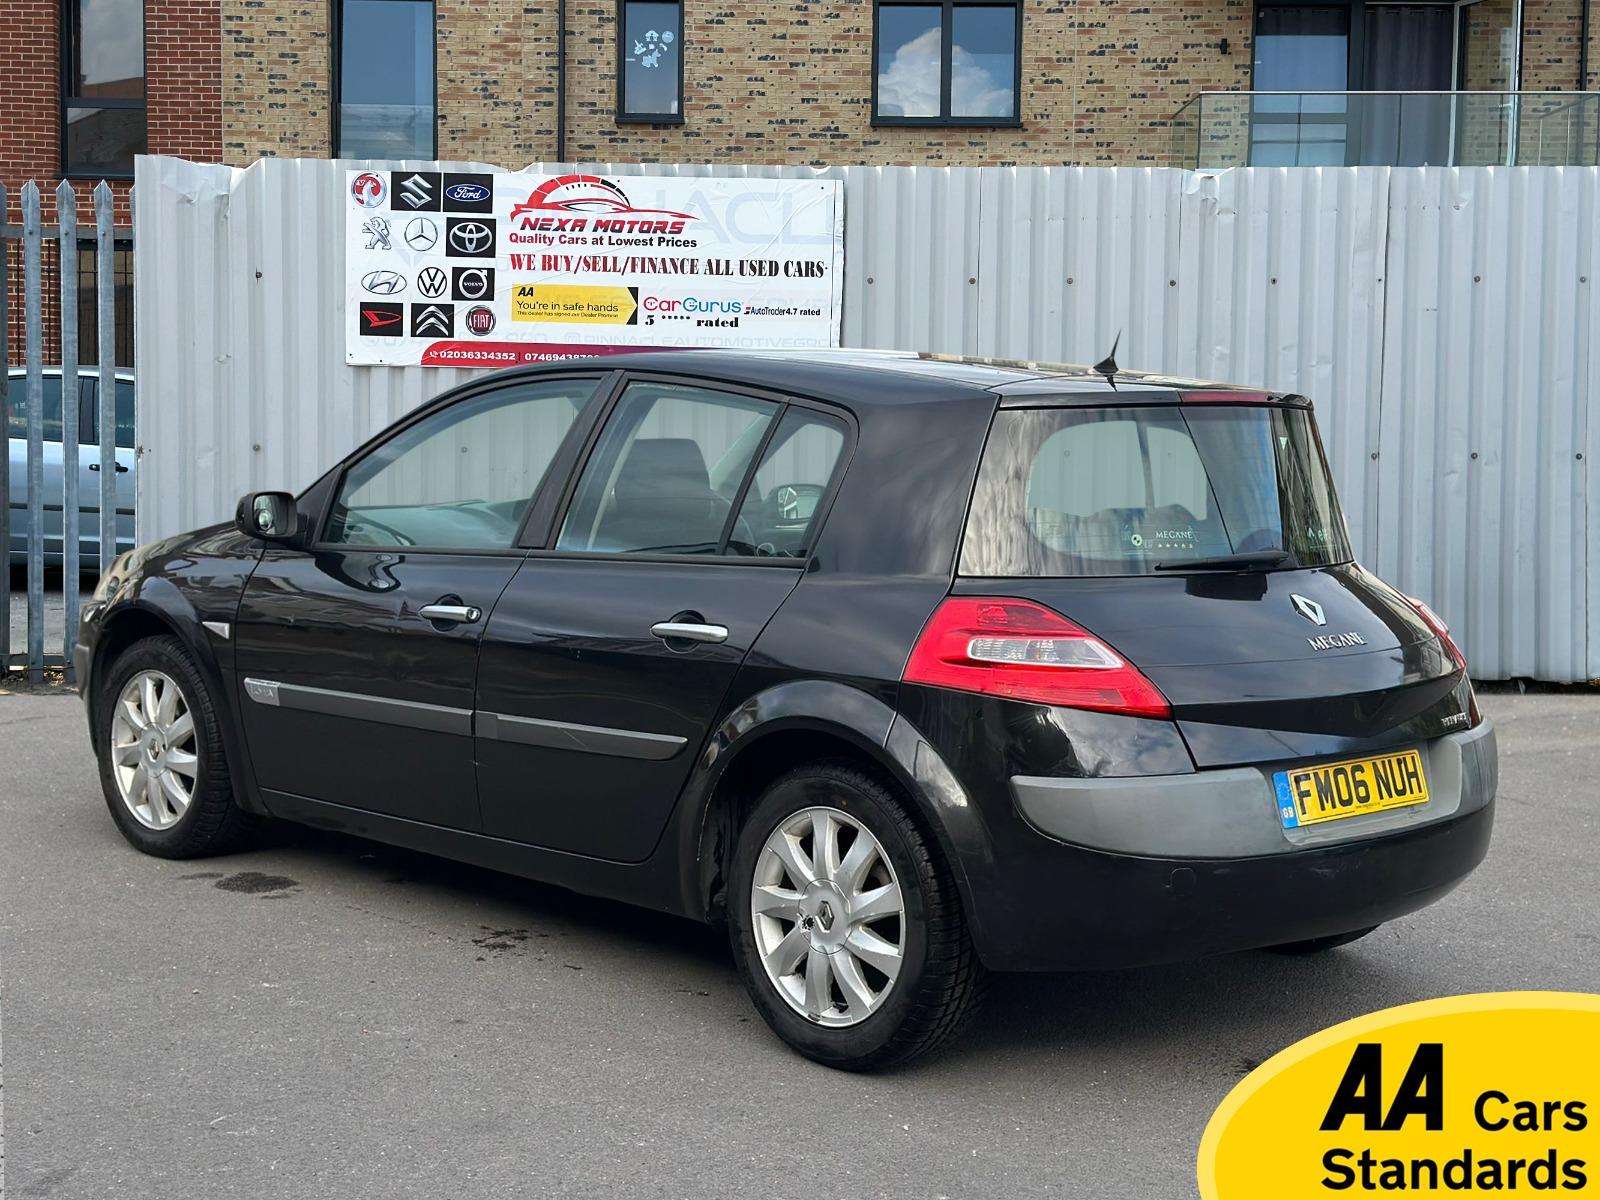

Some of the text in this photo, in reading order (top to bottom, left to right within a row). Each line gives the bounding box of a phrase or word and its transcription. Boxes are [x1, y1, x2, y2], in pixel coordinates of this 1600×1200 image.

[453, 187, 481, 199] Ford
[520, 217, 685, 235] NEXA MOTORS
[509, 233, 697, 248] Quality Cars at Lowest Prices
[509, 254, 536, 271] WE
[541, 254, 699, 276] BUY/SELL/FINANCE
[704, 258, 734, 276] ALL
[739, 259, 779, 277] USED
[517, 286, 534, 297] AA
[516, 301, 619, 312] You're in safe hands
[643, 297, 742, 313] CarGurus
[800, 308, 821, 316] rated
[473, 314, 490, 328] FIAT
[645, 314, 739, 328] 5 rated
[440, 351, 516, 361] 02036334352
[1306, 631, 1368, 651] MEGANE
[1293, 755, 1423, 816] FM06 NUH
